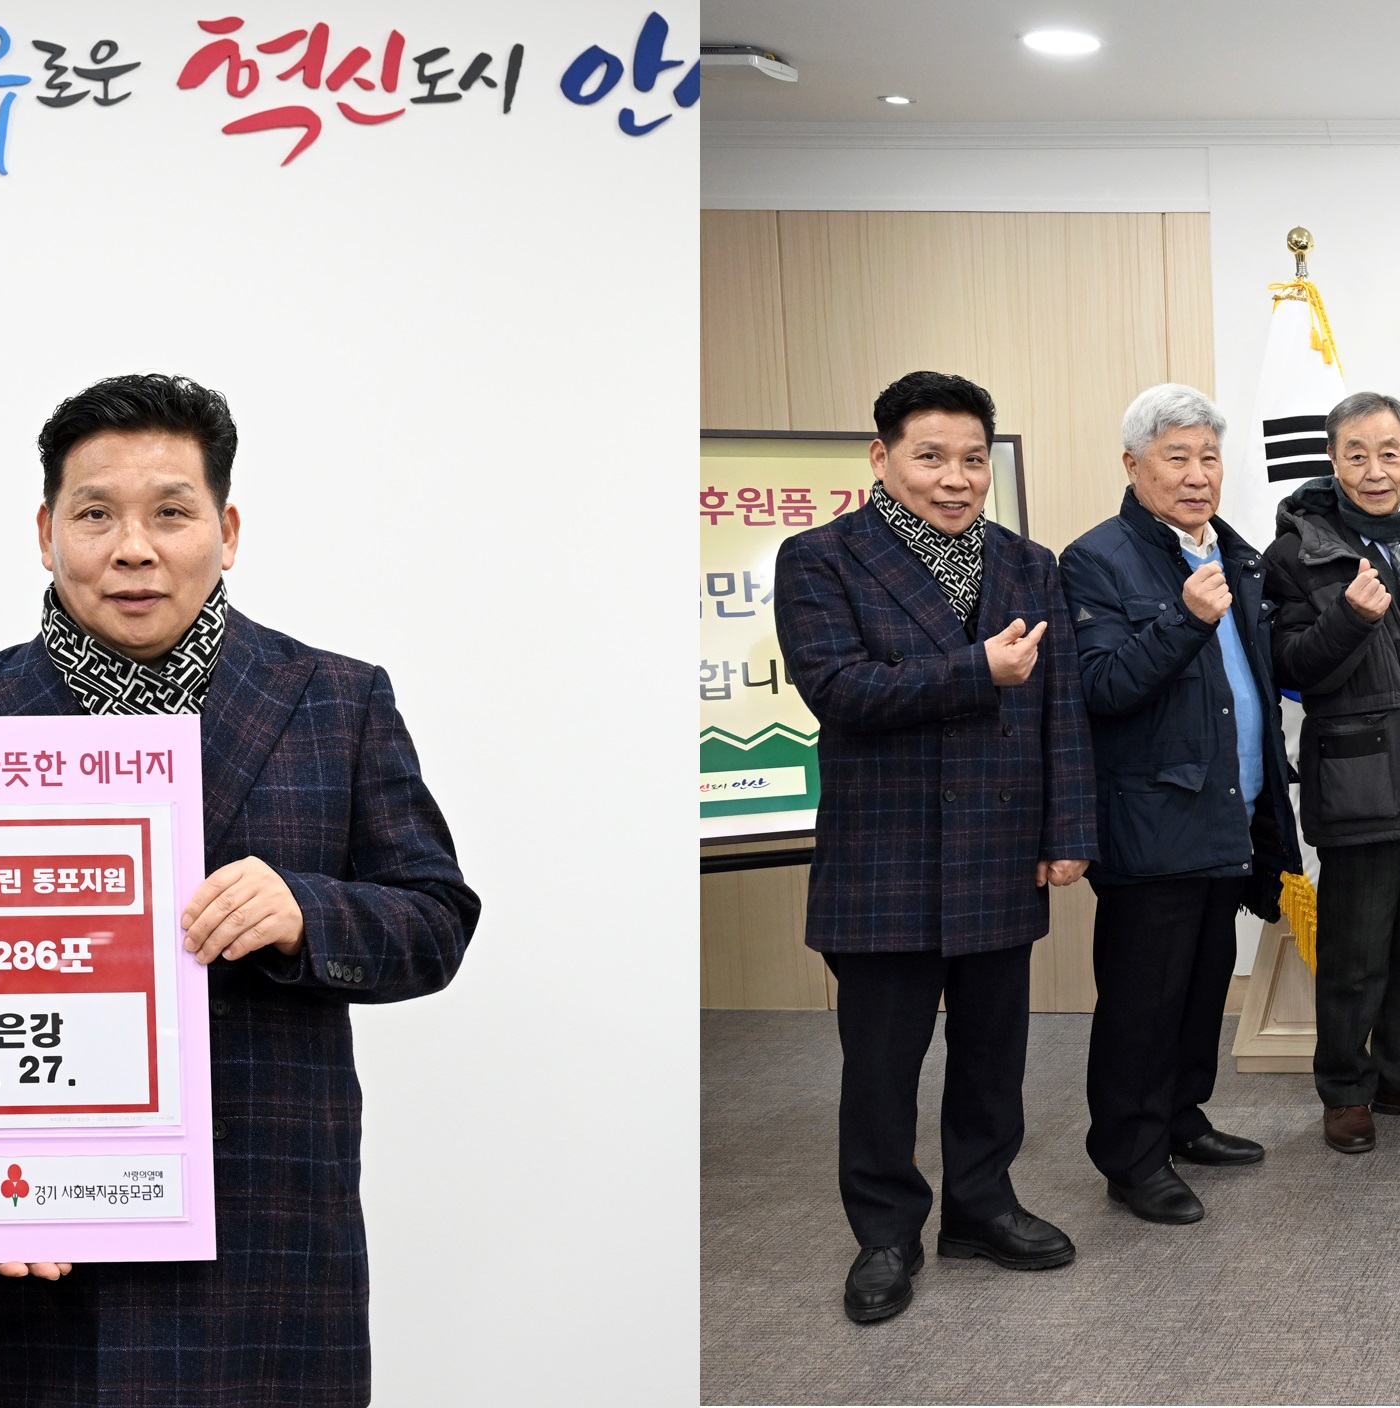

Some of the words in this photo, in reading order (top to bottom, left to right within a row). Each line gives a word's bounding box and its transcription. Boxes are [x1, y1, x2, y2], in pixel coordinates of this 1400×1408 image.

[176, 16, 524, 166] 혁신도시
[830, 489, 872, 517] 기
[700, 659, 793, 700] 합니
[80, 750, 173, 784] 에너지
[33, 868, 125, 893] 동포지원
[19, 1056, 75, 1086] 27.
[35, 1186, 56, 1205] 경기
[62, 1184, 163, 1204] 사회복지공동모금회
